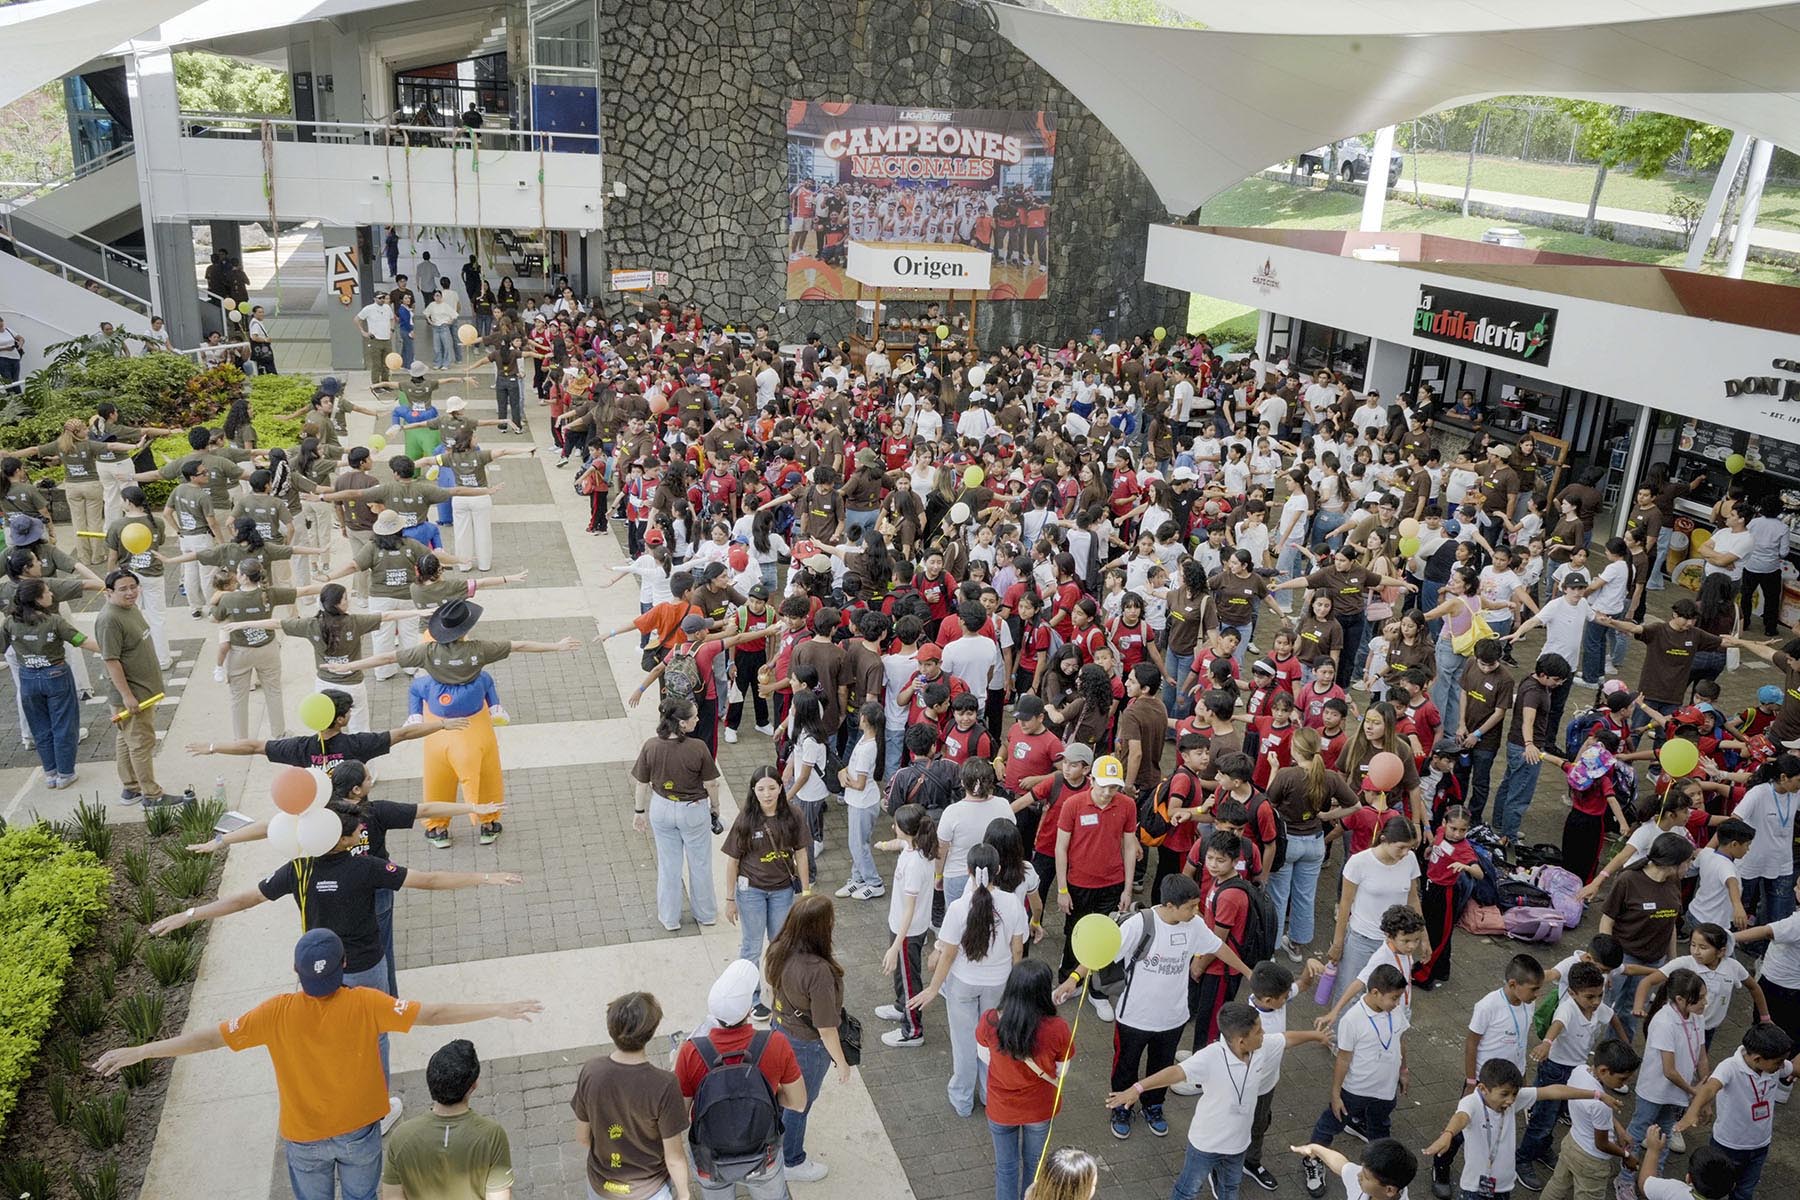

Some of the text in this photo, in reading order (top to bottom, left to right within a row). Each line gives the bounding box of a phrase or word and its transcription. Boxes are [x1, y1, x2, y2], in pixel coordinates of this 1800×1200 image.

[823, 125, 1021, 164] CAMPEONES
[851, 155, 995, 179] NACIONALES
[893, 255, 969, 280] Origen.
[1419, 290, 1433, 310] La
[1413, 308, 1527, 352] enchiladería
[1723, 376, 1781, 397] DON
